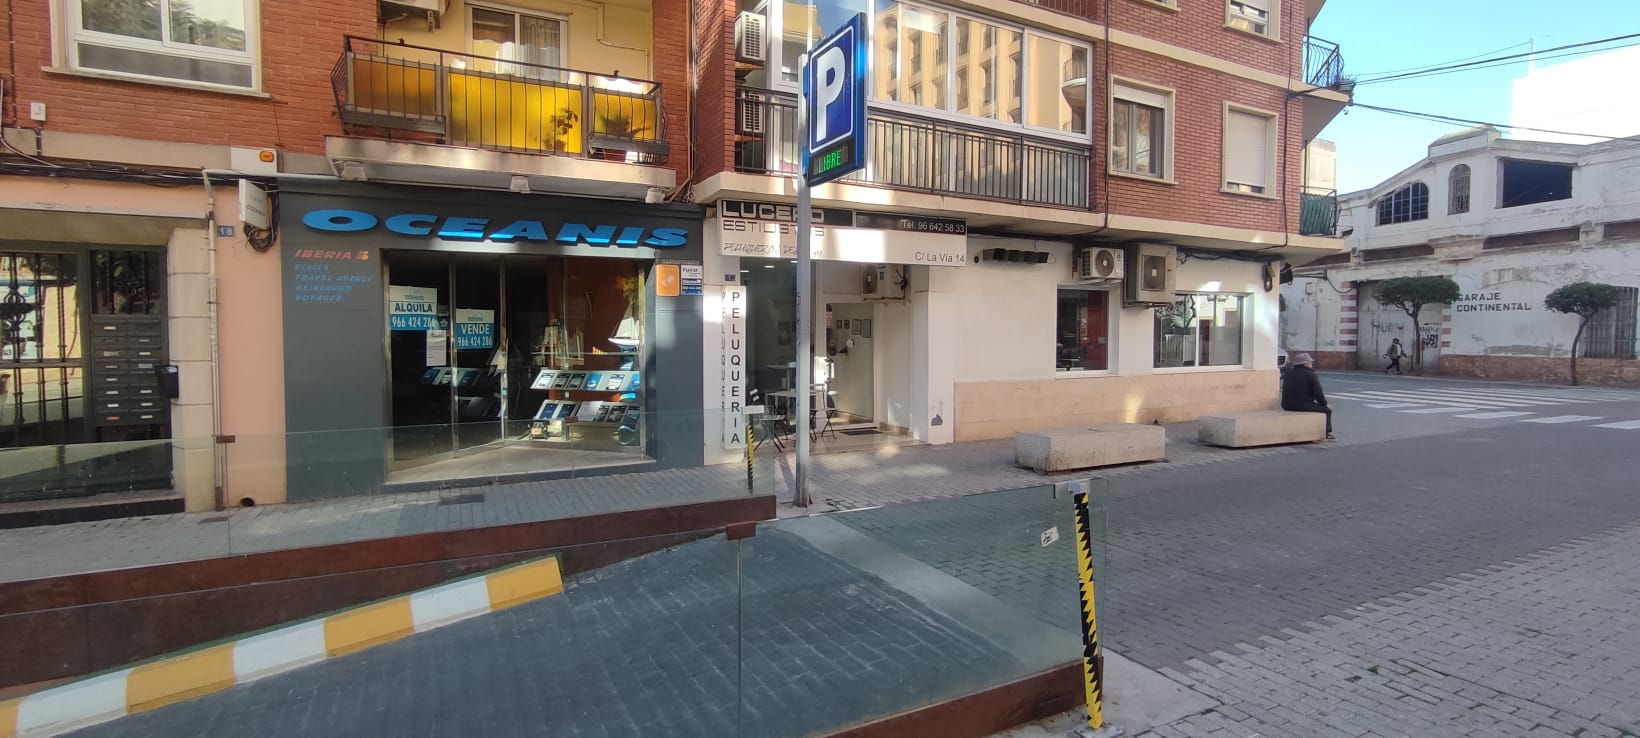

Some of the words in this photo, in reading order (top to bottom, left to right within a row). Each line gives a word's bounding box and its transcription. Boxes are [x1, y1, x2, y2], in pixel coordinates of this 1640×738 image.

[816, 46, 845, 142] P
[818, 150, 841, 173] LIBRE
[302, 208, 689, 248] OCEANIS
[918, 221, 928, 230] 96
[929, 223, 943, 232] 642
[944, 223, 954, 232] 58
[955, 224, 965, 232] 33
[294, 249, 353, 259] IBERIA
[914, 251, 924, 261] C/
[926, 252, 937, 262] La
[955, 254, 965, 263] 14
[394, 302, 433, 313] ALQUILA
[1456, 302, 1531, 312] CONTINENTAL
[391, 316, 405, 327] 966
[407, 317, 421, 328] 424
[461, 323, 490, 335] VENDE
[457, 336, 469, 347] 966
[470, 336, 481, 346] 424
[482, 335, 493, 346] 286
[731, 291, 741, 444] PELUQUERIA
